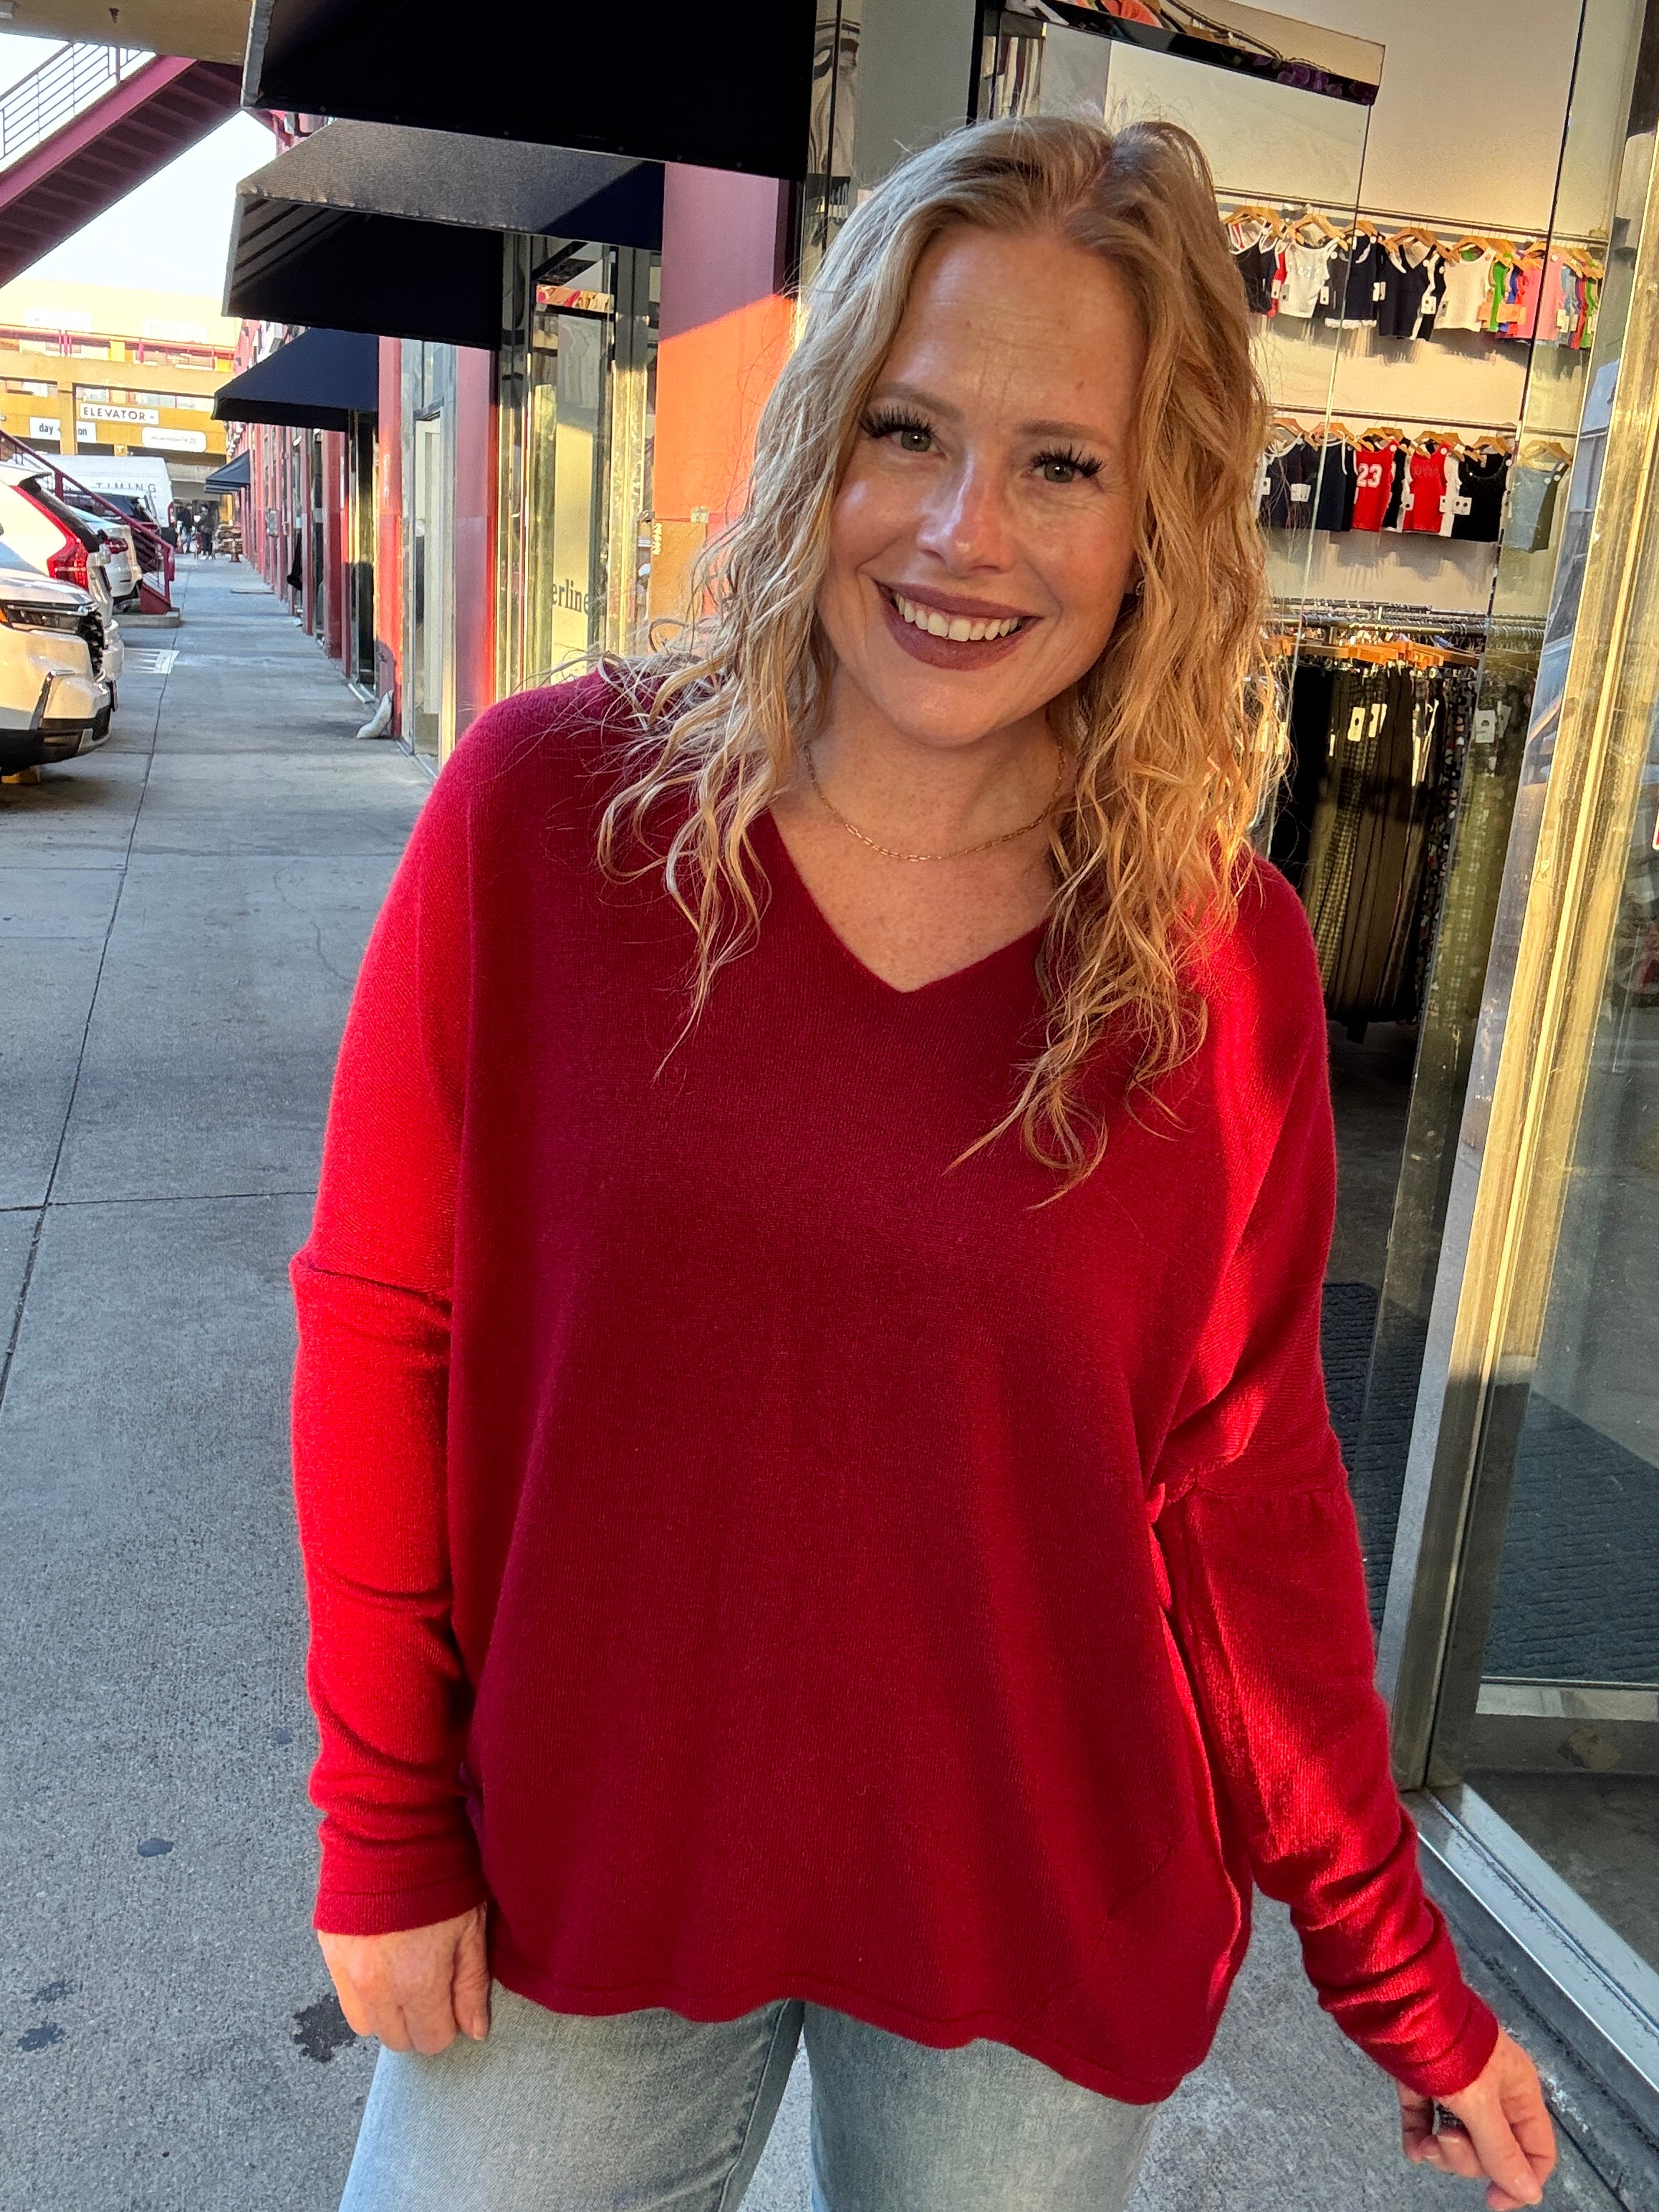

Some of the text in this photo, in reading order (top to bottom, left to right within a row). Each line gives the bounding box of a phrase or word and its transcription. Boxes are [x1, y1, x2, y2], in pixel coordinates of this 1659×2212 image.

[84, 407, 146, 420] ELEVATOR
[39, 423, 54, 436] day
[1357, 463, 1382, 488] 23
